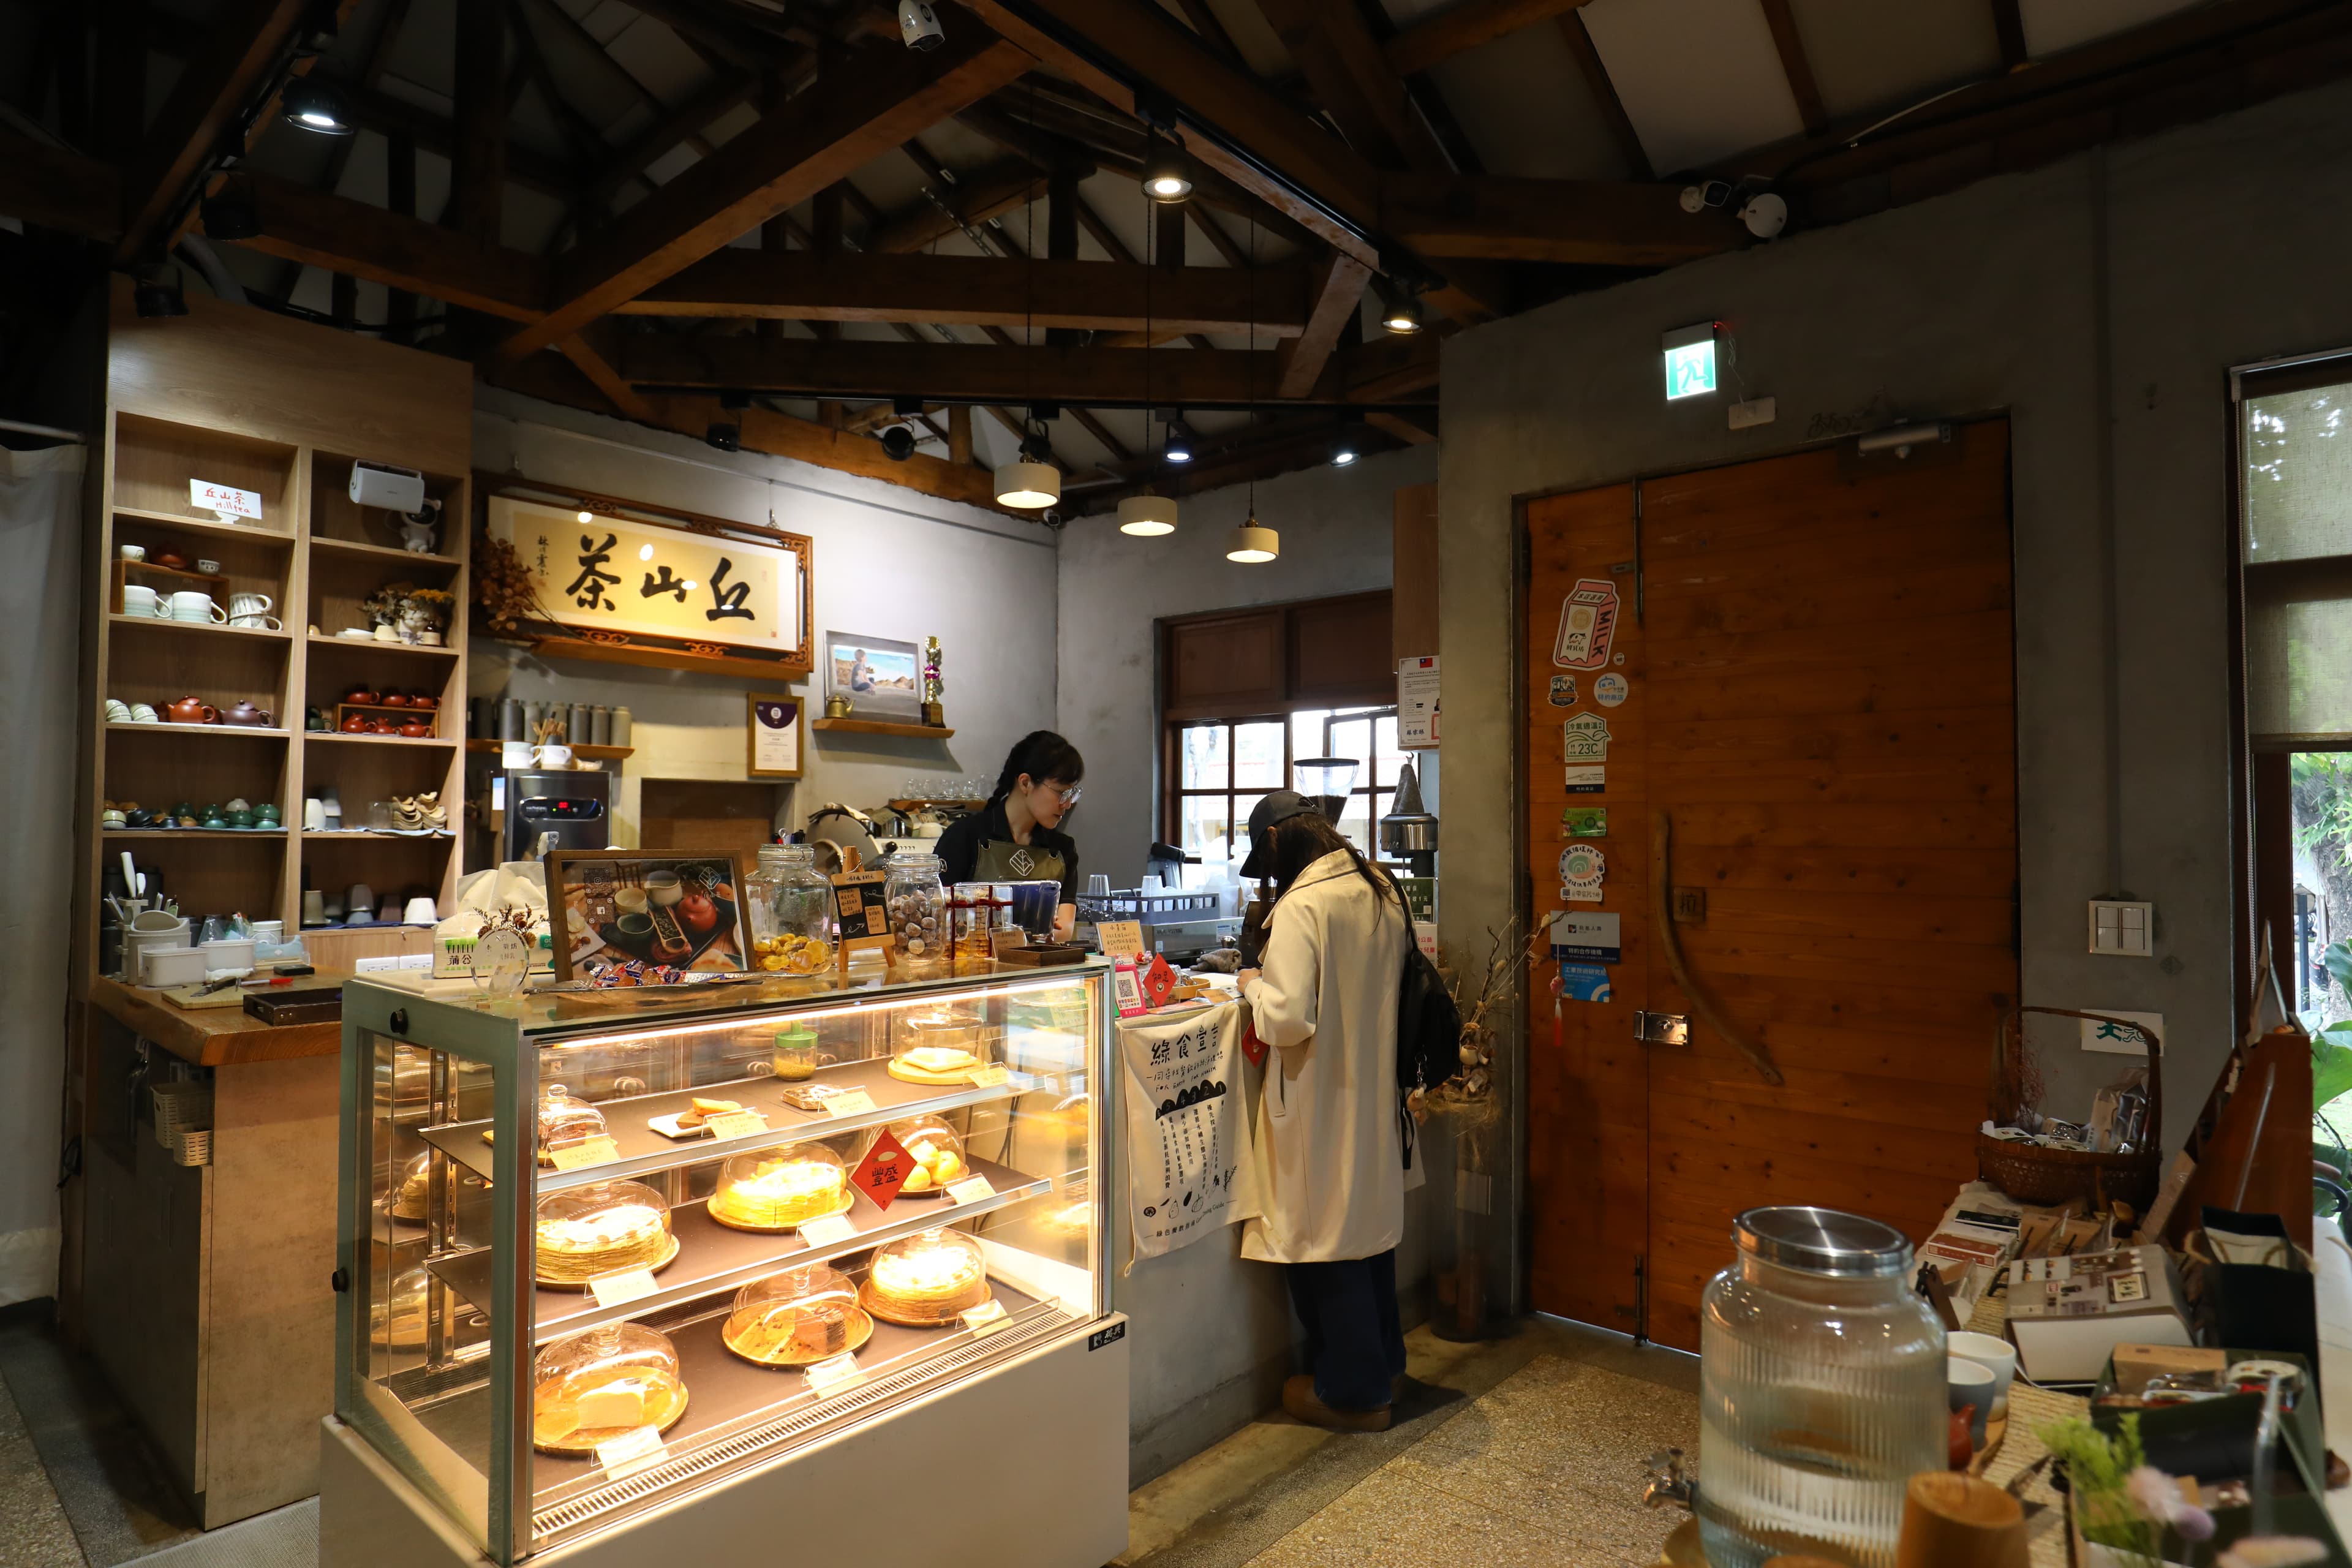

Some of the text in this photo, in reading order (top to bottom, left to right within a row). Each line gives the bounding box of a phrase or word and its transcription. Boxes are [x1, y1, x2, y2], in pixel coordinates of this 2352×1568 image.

[205, 488, 245, 505] 丘山茶
[1592, 610, 1612, 658] MILK
[1150, 1023, 1219, 1066] 綠食宣言
[872, 1163, 899, 1187] 豐盛
